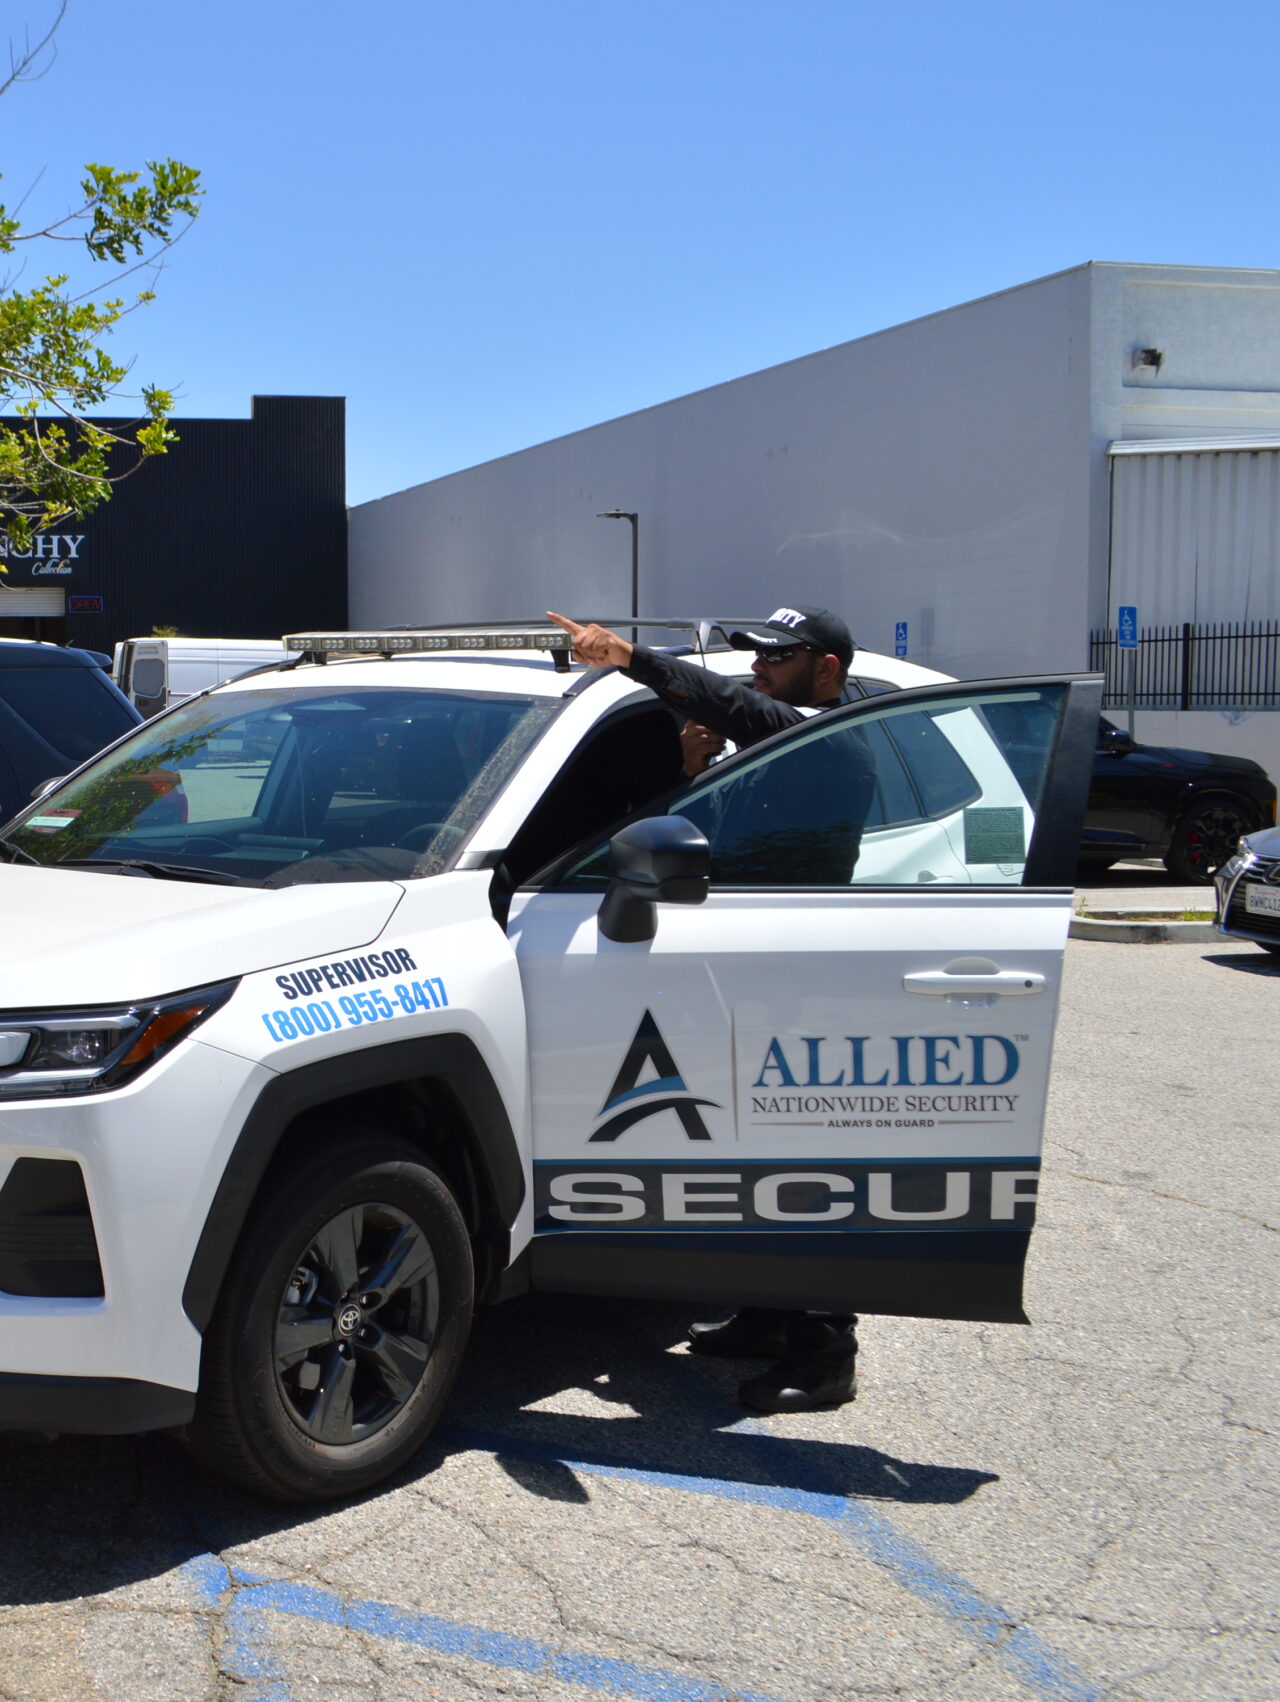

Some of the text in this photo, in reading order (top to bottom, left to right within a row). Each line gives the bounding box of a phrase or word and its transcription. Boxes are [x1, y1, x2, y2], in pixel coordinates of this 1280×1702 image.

[31, 559, 73, 575] Collection
[275, 947, 418, 1000] SUPERVISOR
[261, 976, 449, 1043] (800) 955-8417
[751, 1034, 1020, 1088] ALLIED
[751, 1094, 1019, 1114] NATIONWIDE SECURITY
[827, 1119, 935, 1129] ALWAYS ON GUARD
